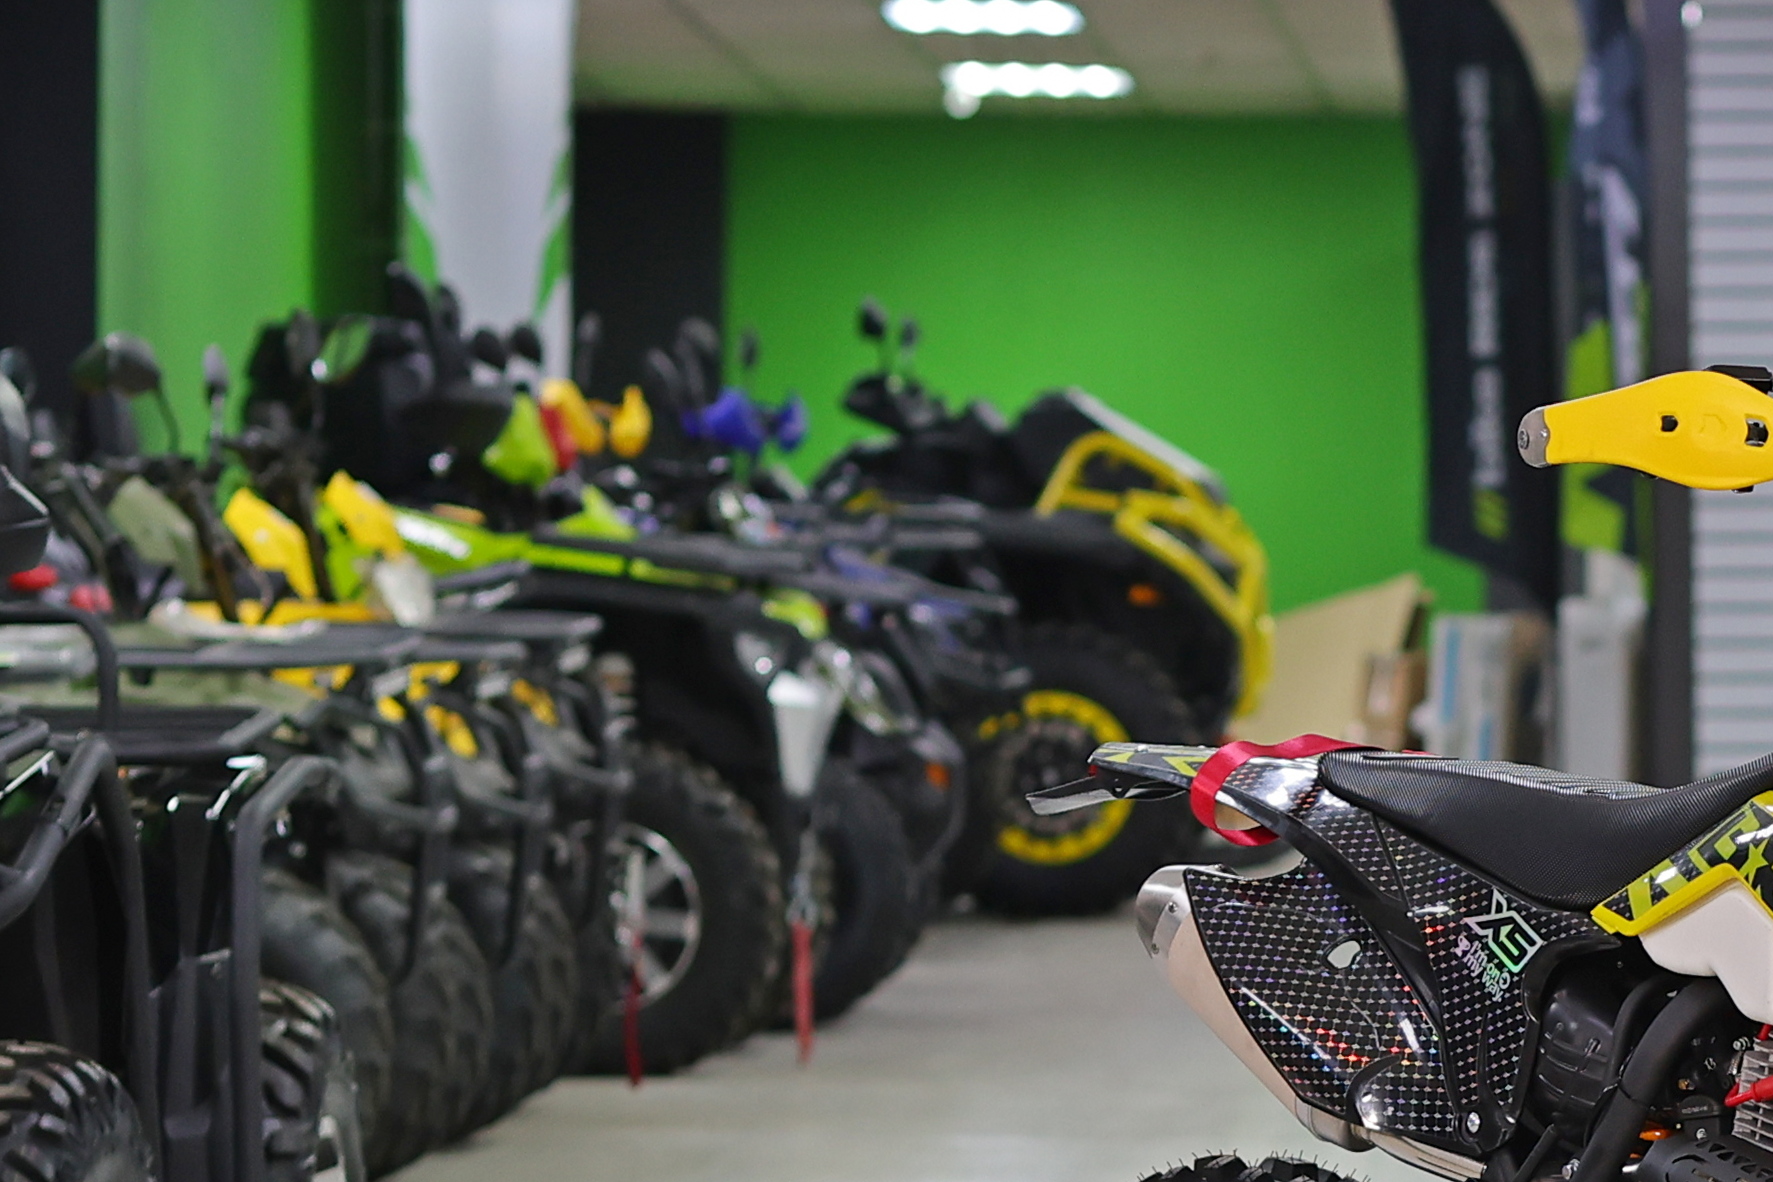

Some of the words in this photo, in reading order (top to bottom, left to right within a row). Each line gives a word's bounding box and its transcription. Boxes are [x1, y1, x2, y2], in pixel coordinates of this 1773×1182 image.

[1463, 887, 1544, 974] XS
[1463, 953, 1484, 977] my
[1470, 940, 1488, 968] I'm
[1486, 962, 1502, 983] on
